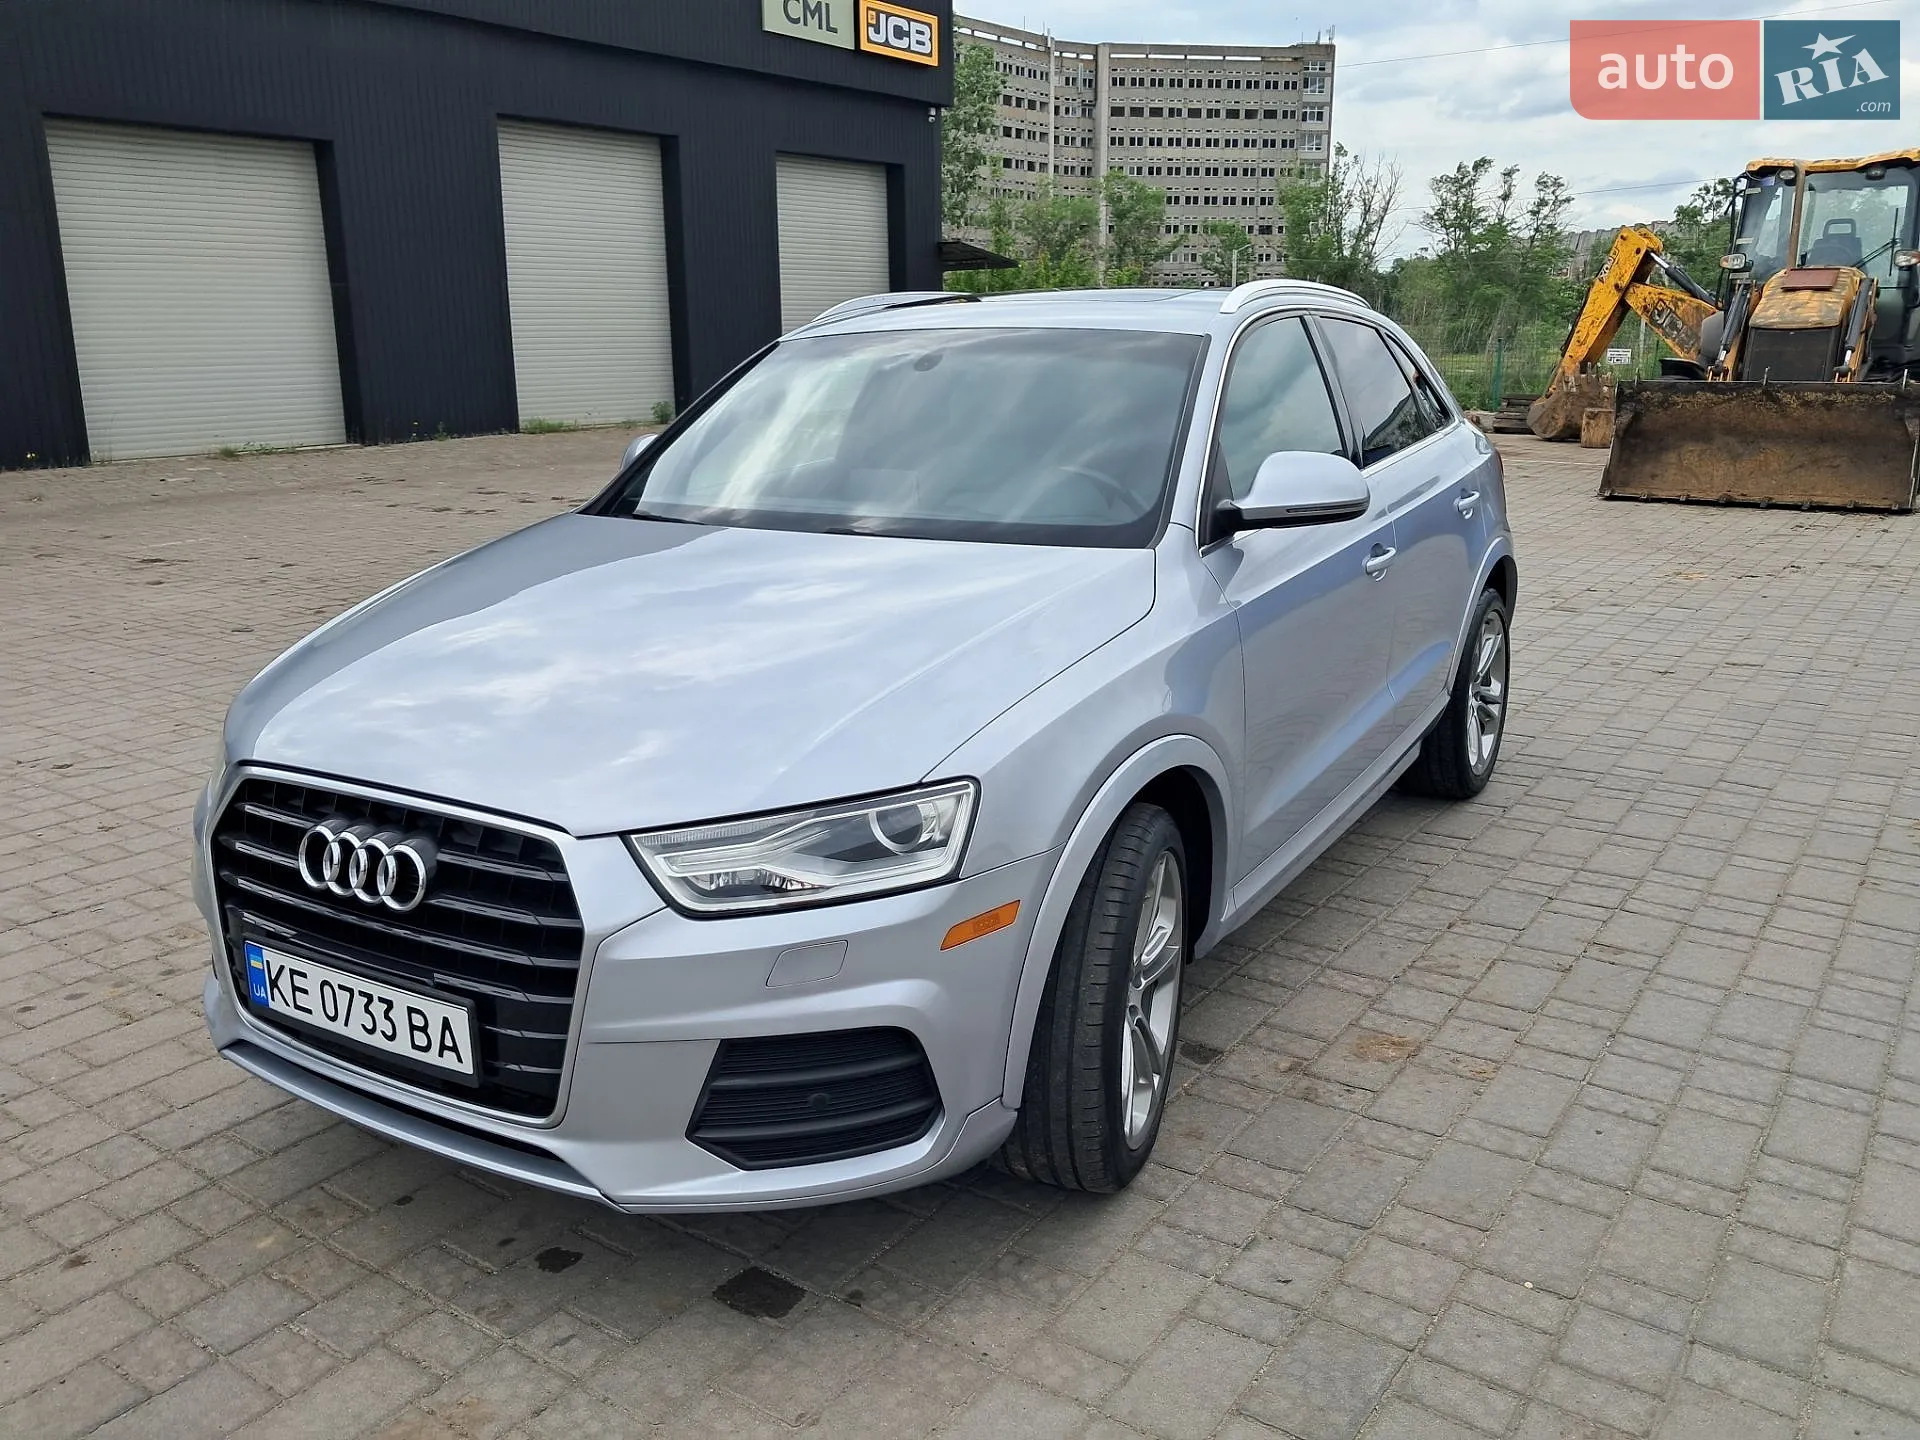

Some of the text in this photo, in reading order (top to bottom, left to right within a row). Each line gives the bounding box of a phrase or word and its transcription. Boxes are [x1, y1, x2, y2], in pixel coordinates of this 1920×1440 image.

[783, 0, 838, 34] CML
[868, 12, 932, 54] JCB
[253, 983, 267, 999] UA
[266, 960, 464, 1064] KE 0733 BA
